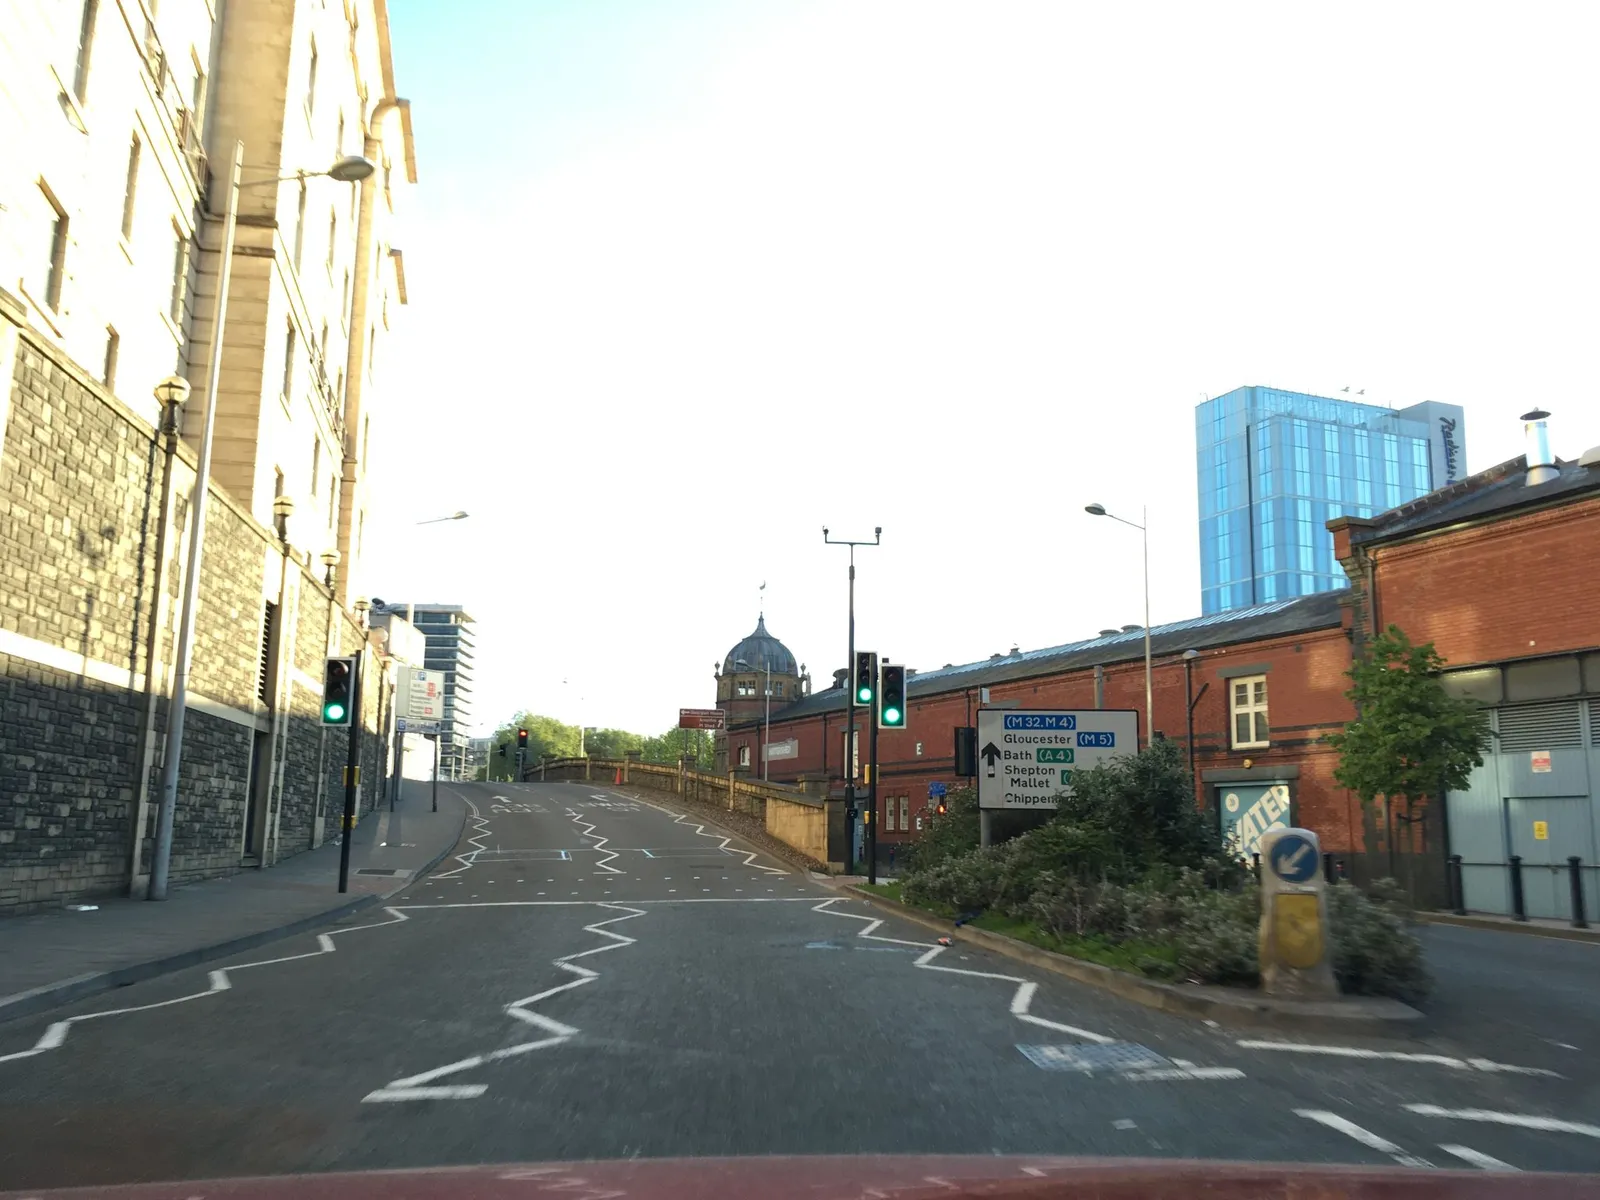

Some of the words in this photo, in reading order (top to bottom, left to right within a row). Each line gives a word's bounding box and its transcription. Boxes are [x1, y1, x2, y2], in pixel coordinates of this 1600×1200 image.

[1004, 733, 1072, 744] Gloucester
[1004, 750, 1032, 760] Bath
[1005, 765, 1055, 776] Shepton
[1010, 778, 1050, 788] Mallet
